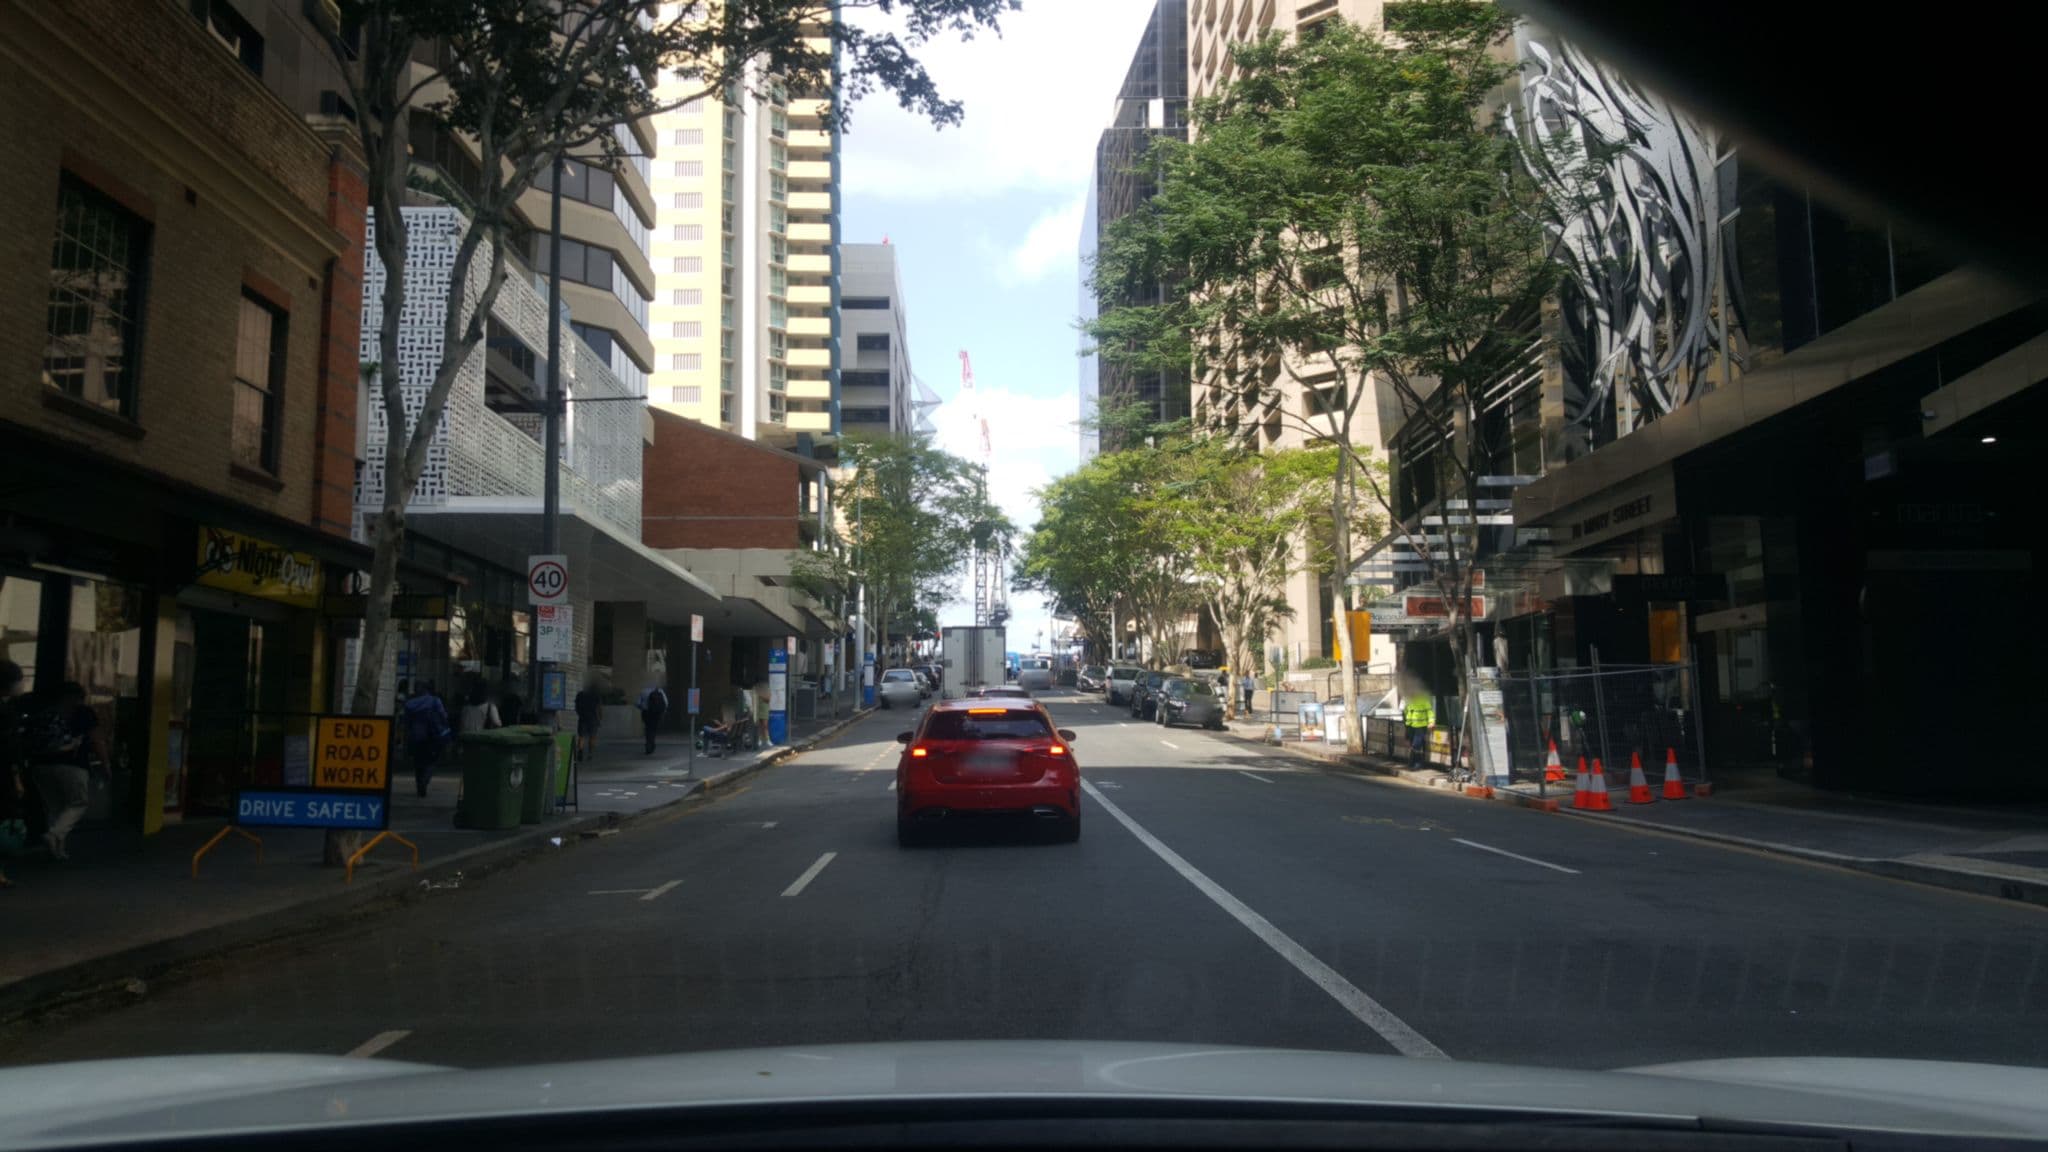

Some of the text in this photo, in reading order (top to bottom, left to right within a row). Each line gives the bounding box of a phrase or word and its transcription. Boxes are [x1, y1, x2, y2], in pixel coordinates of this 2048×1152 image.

[1612, 495, 1651, 524] STREET
[534, 570, 561, 588] 40
[539, 625, 554, 636] 3P
[335, 722, 374, 739] END
[325, 744, 381, 762] ROAD
[322, 767, 378, 785] WORK
[239, 799, 382, 820] DRIVE SAFELY
